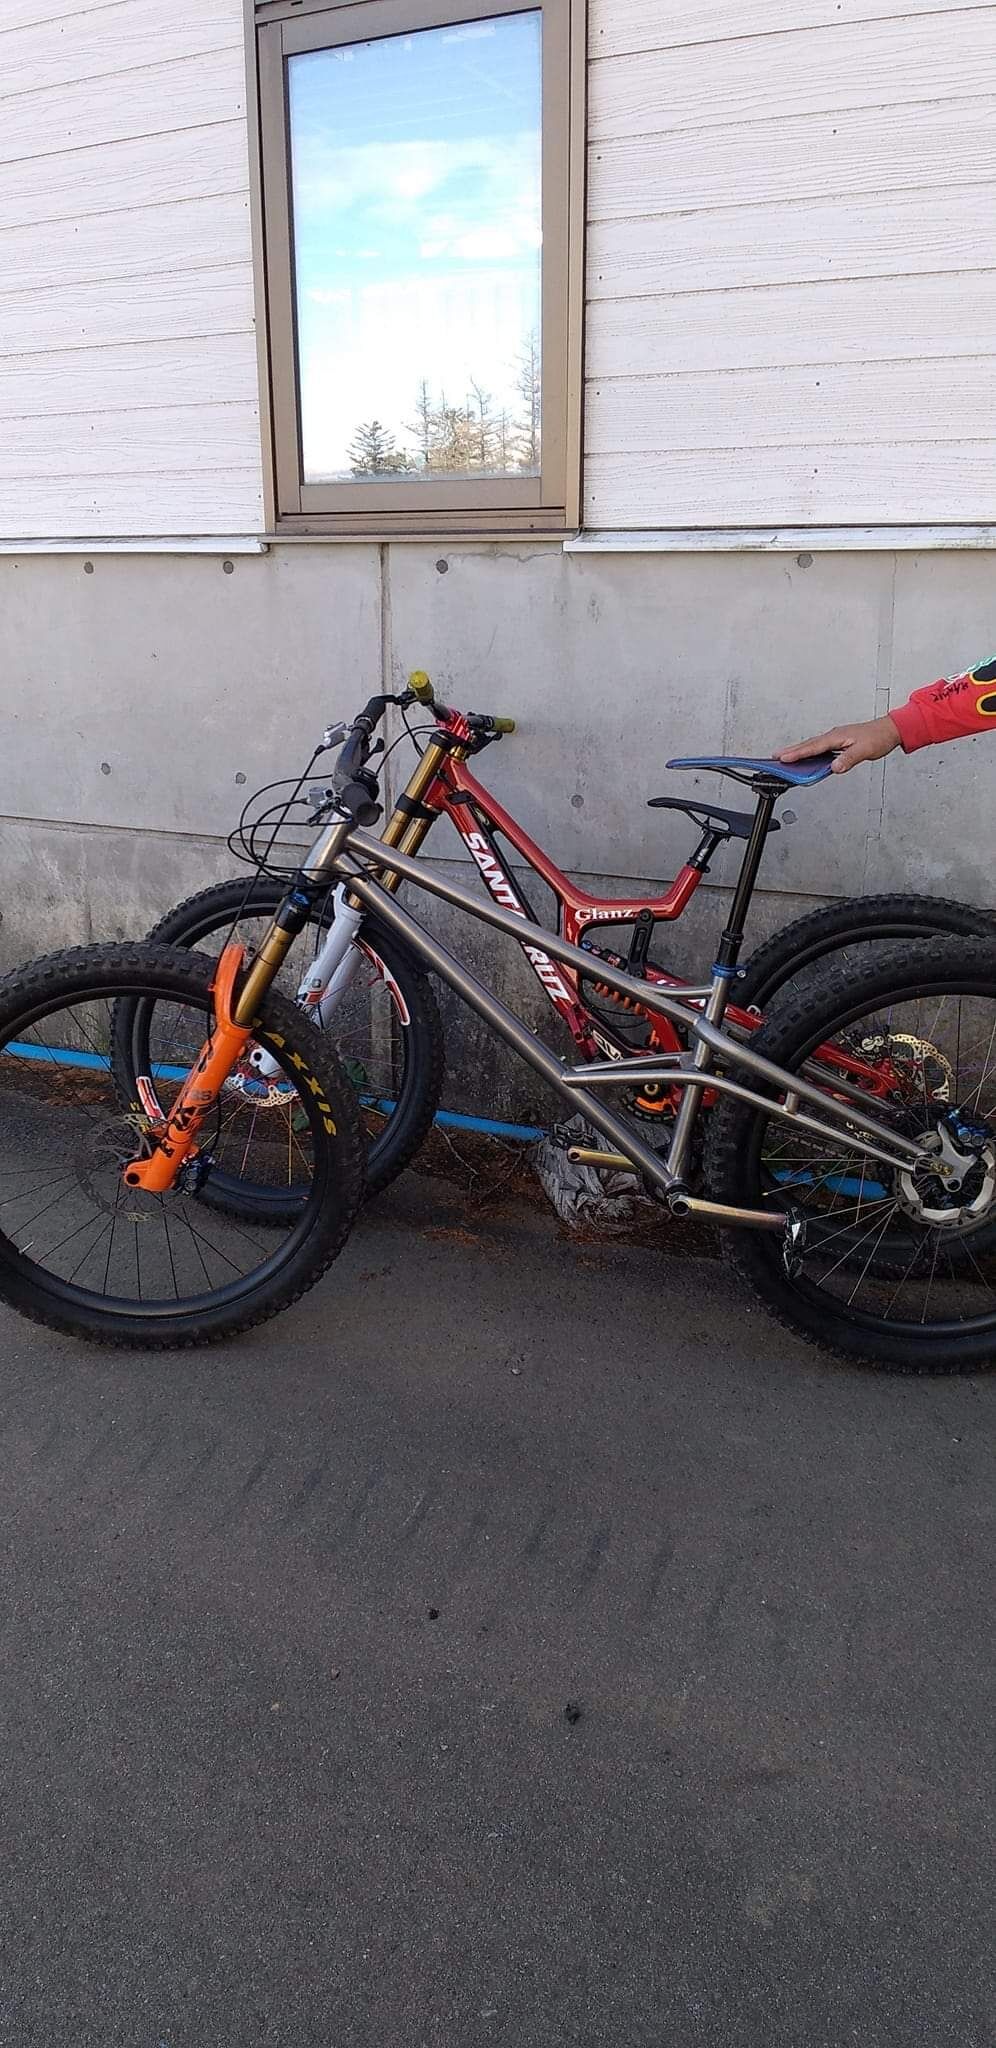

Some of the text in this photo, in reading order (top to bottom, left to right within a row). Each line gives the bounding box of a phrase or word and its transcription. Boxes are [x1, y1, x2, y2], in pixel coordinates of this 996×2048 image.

[462, 831, 575, 1005] SANT RUZ
[574, 907, 634, 921] Glanz
[253, 1017, 338, 1137] AXXIS
